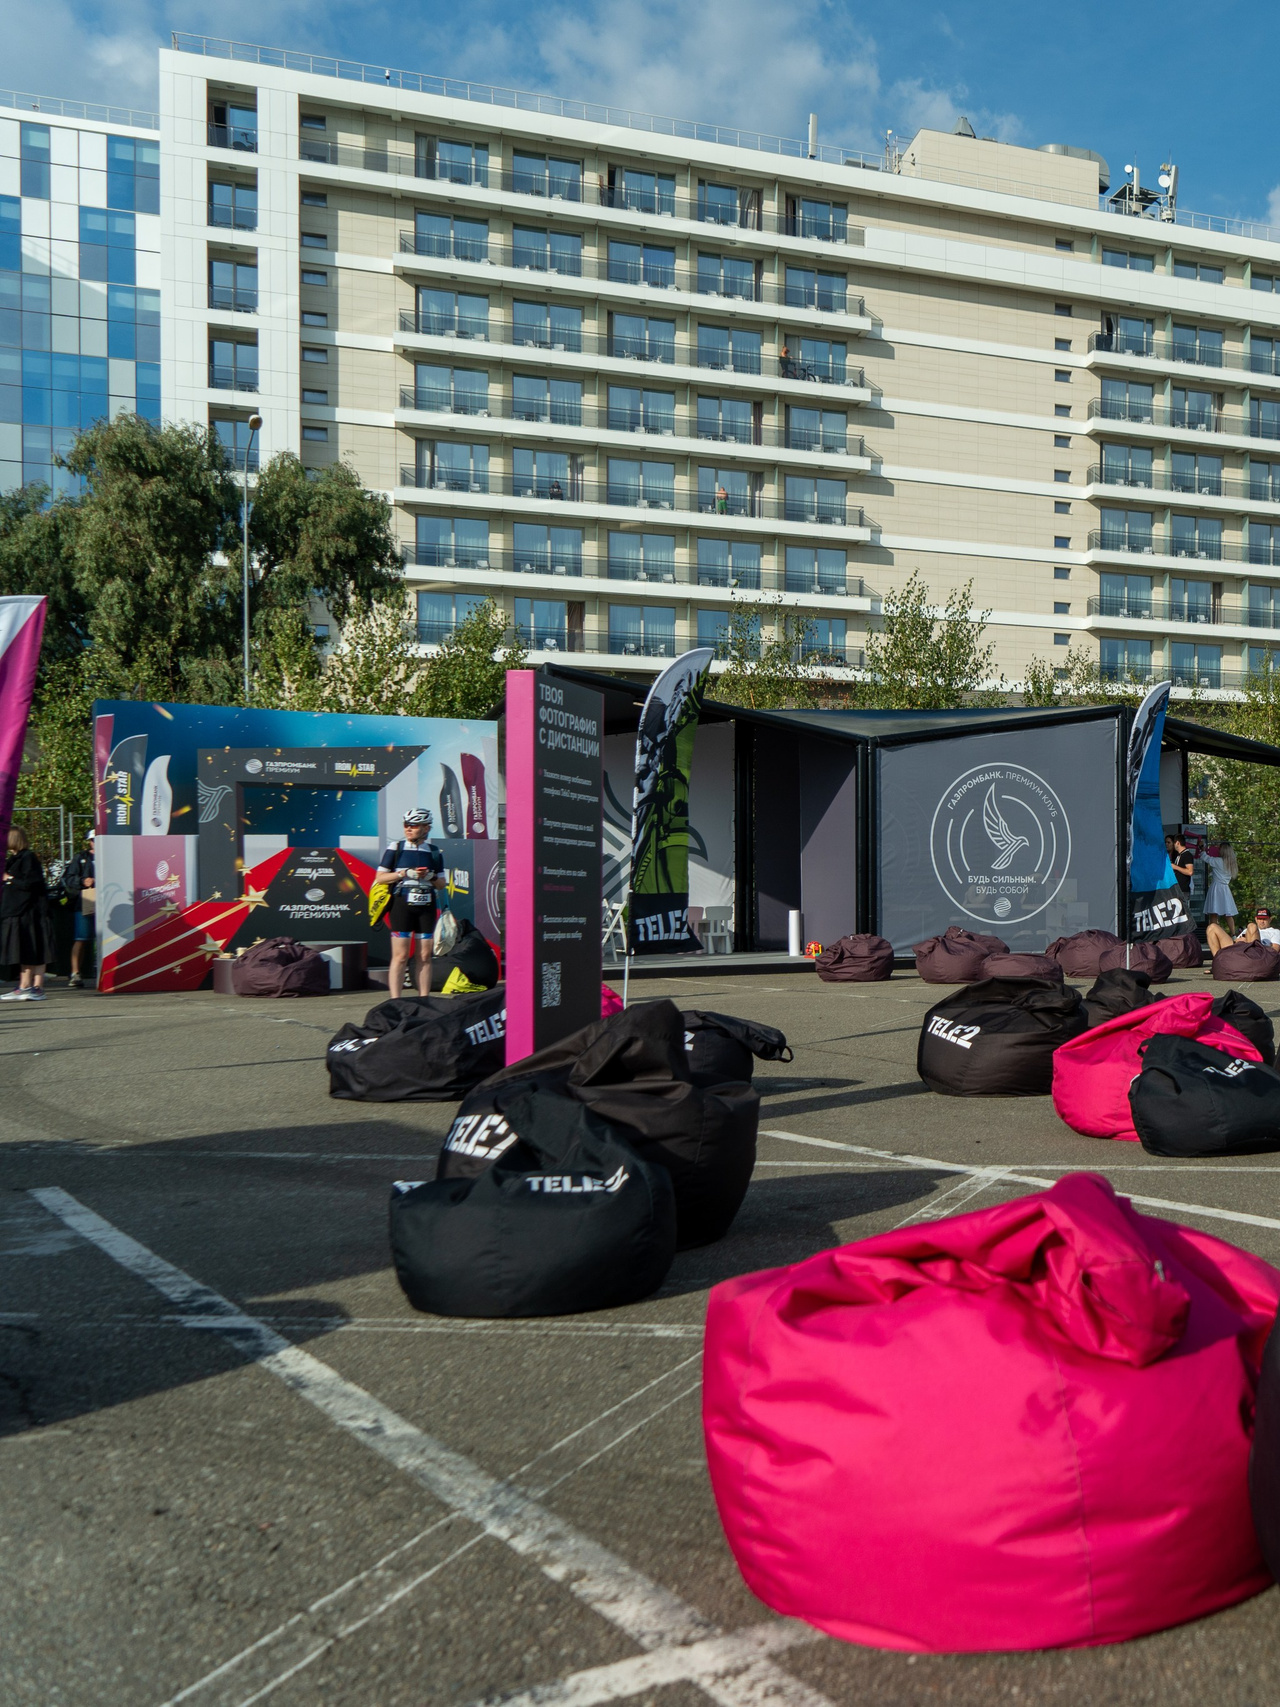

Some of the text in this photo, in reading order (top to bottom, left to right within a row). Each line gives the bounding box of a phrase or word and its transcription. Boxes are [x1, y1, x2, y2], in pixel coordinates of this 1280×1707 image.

[539, 683, 563, 706] ТВОЯ
[539, 706, 597, 736] ФОТОГРАФИЯ
[539, 727, 599, 758] С ДИСТАНЦИИ
[357, 763, 375, 772] STAR
[116, 771, 129, 825] IRON STAR
[948, 771, 1058, 818] ГАЗПРОМБАНК. ПРЕМИУМ КЛУБ
[454, 869, 469, 888] STAR
[968, 875, 1037, 884] БУДЬ СИЛЬНЫМ.
[976, 884, 1029, 895] БУДЬ СОБОЙ
[1134, 898, 1188, 932] TELE2
[928, 1015, 981, 1049] TELE2
[526, 1165, 630, 1193] TELE2
